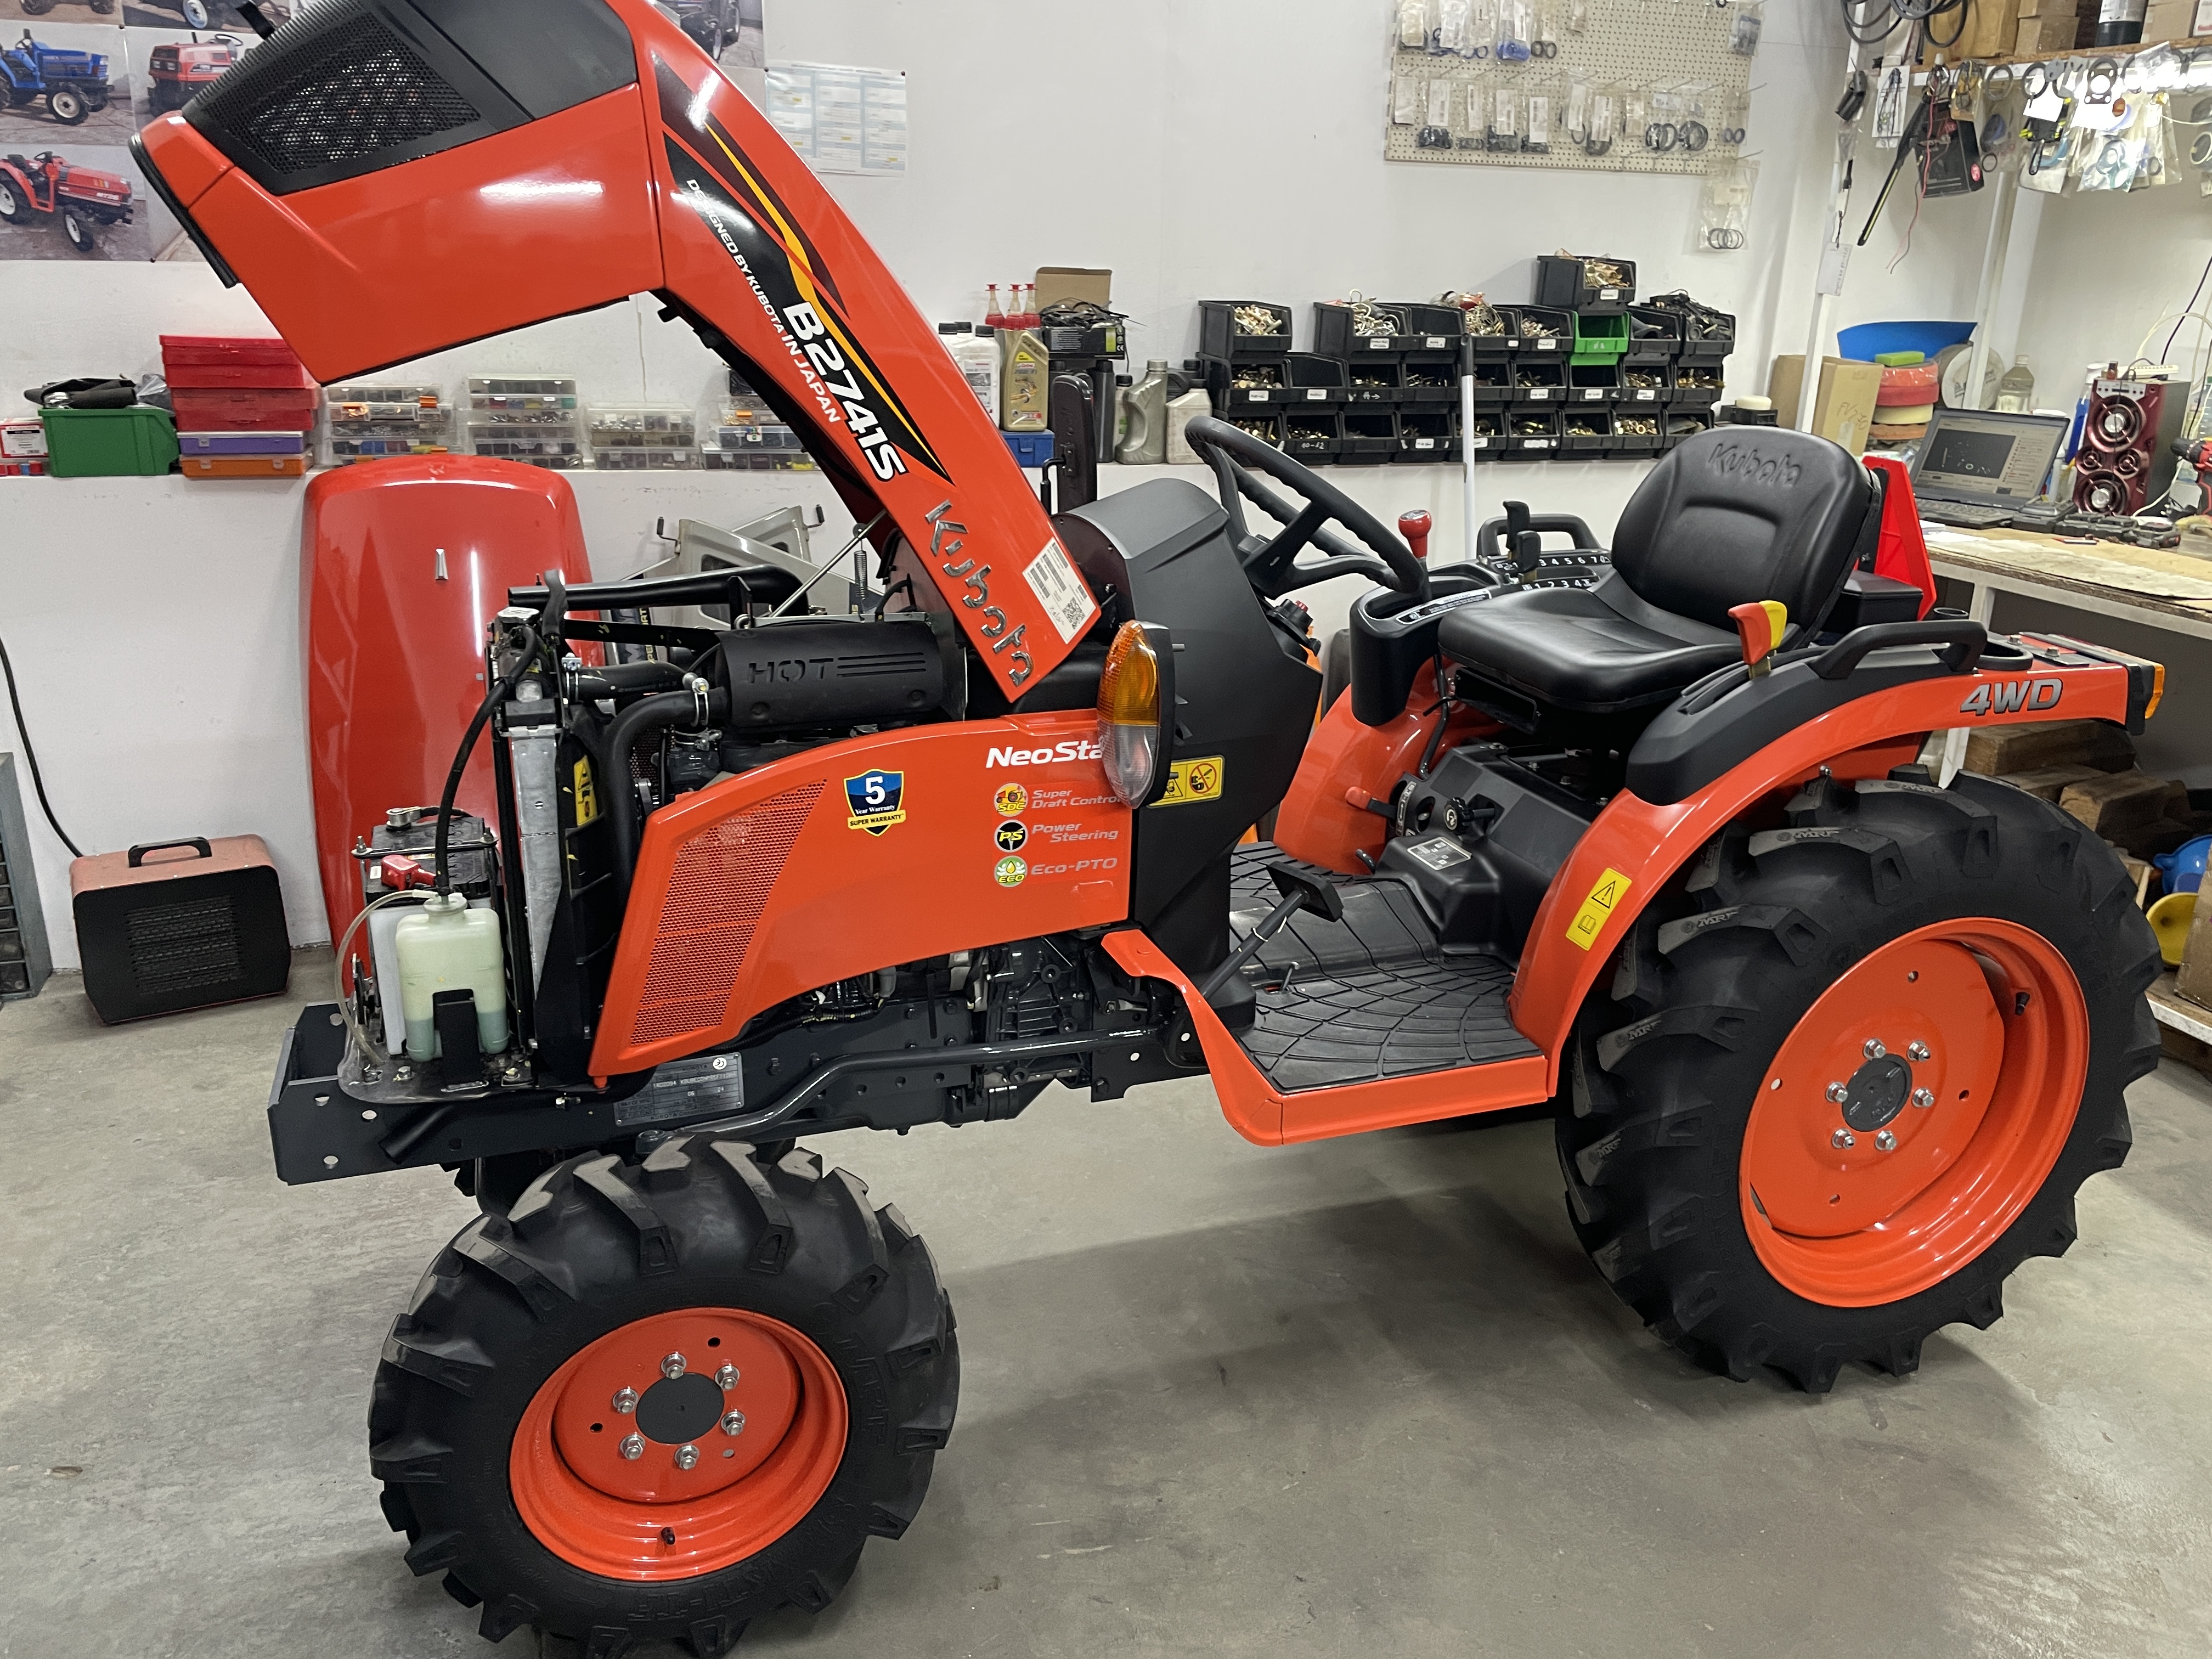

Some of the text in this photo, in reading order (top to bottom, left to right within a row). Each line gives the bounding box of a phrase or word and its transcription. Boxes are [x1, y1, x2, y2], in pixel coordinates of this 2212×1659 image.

[686, 179, 841, 423] DESIGNED BY KUBOTA IN JAPAN
[783, 302, 906, 479] B2741S
[1708, 443, 1801, 487] Kubota
[925, 499, 1034, 687] Kubota
[748, 657, 834, 684] HOT
[1960, 678, 2063, 716] 4WD
[986, 740, 1103, 769] NeoSta
[865, 776, 885, 805] 5
[1032, 789, 1072, 799] Super
[998, 802, 1025, 812] SDC
[1031, 795, 1120, 809] Draft Contro
[999, 831, 1023, 842] PS
[1031, 823, 1082, 834] Power
[1049, 830, 1118, 843] Steering
[1031, 857, 1118, 875] Eco-PTO
[998, 874, 1025, 884] ECO
